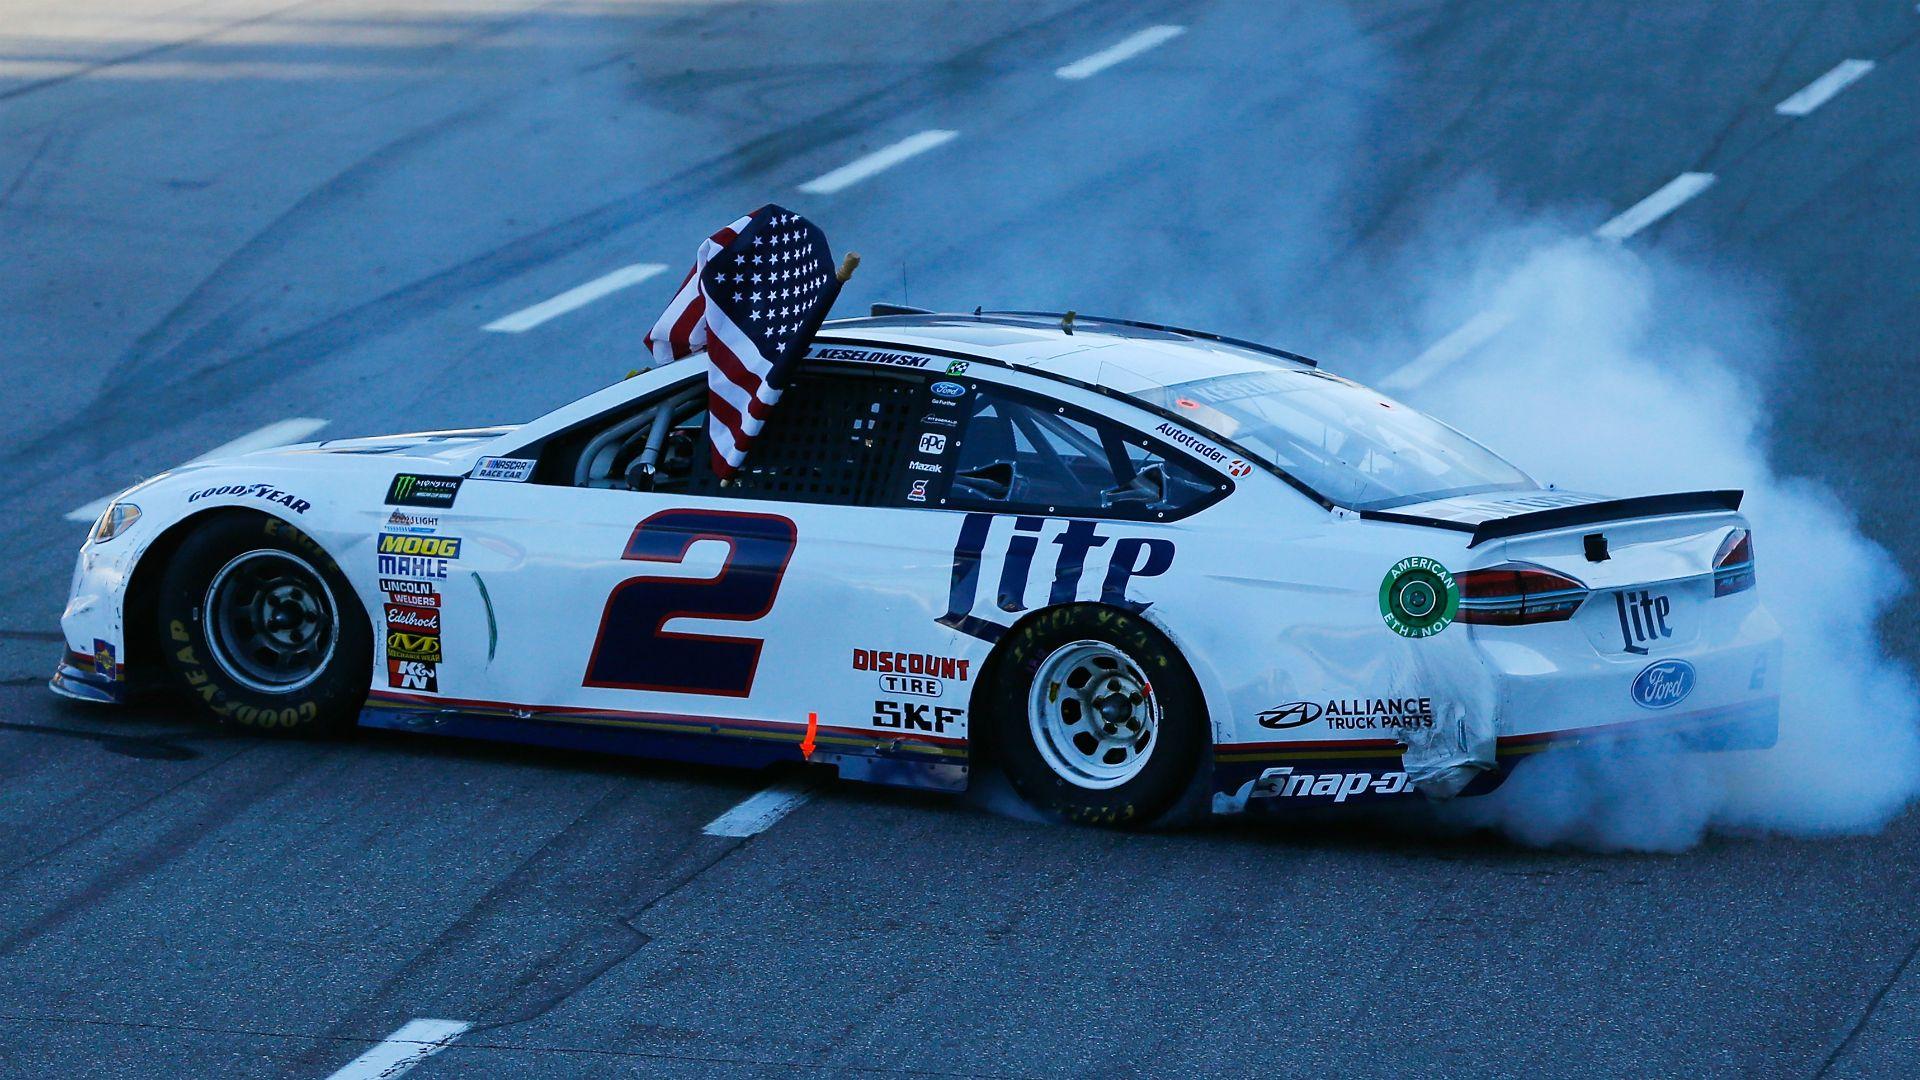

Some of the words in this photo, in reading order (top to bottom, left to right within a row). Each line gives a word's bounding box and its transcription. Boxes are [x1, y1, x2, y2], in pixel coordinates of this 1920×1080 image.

[815, 348, 931, 368] KESELOWSKI
[921, 435, 945, 451] PPG
[1155, 422, 1228, 464] Autotrader
[479, 469, 502, 479] RACE
[503, 470, 522, 479] CAR
[493, 459, 527, 471] NASCAR
[909, 461, 942, 473] Mazak
[415, 479, 456, 489] MONSTER
[188, 483, 312, 515] GOODYEAR
[415, 516, 439, 526] LIGHT
[380, 536, 458, 557] MOOG
[378, 556, 448, 578] MAHLE
[1391, 557, 1456, 589] AMERICAN
[382, 581, 430, 594] LINCOLN
[934, 513, 1176, 644] Lite
[394, 595, 436, 606] WELDERS
[582, 508, 798, 698] 2
[387, 608, 438, 629] Edelbrock
[1383, 612, 1452, 637] ETHANOL
[1613, 590, 1674, 656] Lite
[853, 648, 970, 681] DISCOUNT
[886, 677, 937, 695] TIRE
[872, 700, 962, 733] SKF
[1325, 697, 1431, 716] ALLIANCE
[1326, 716, 1376, 730] TRUCK
[1381, 715, 1434, 729] PARTS
[1251, 766, 1415, 803] Snap-o
